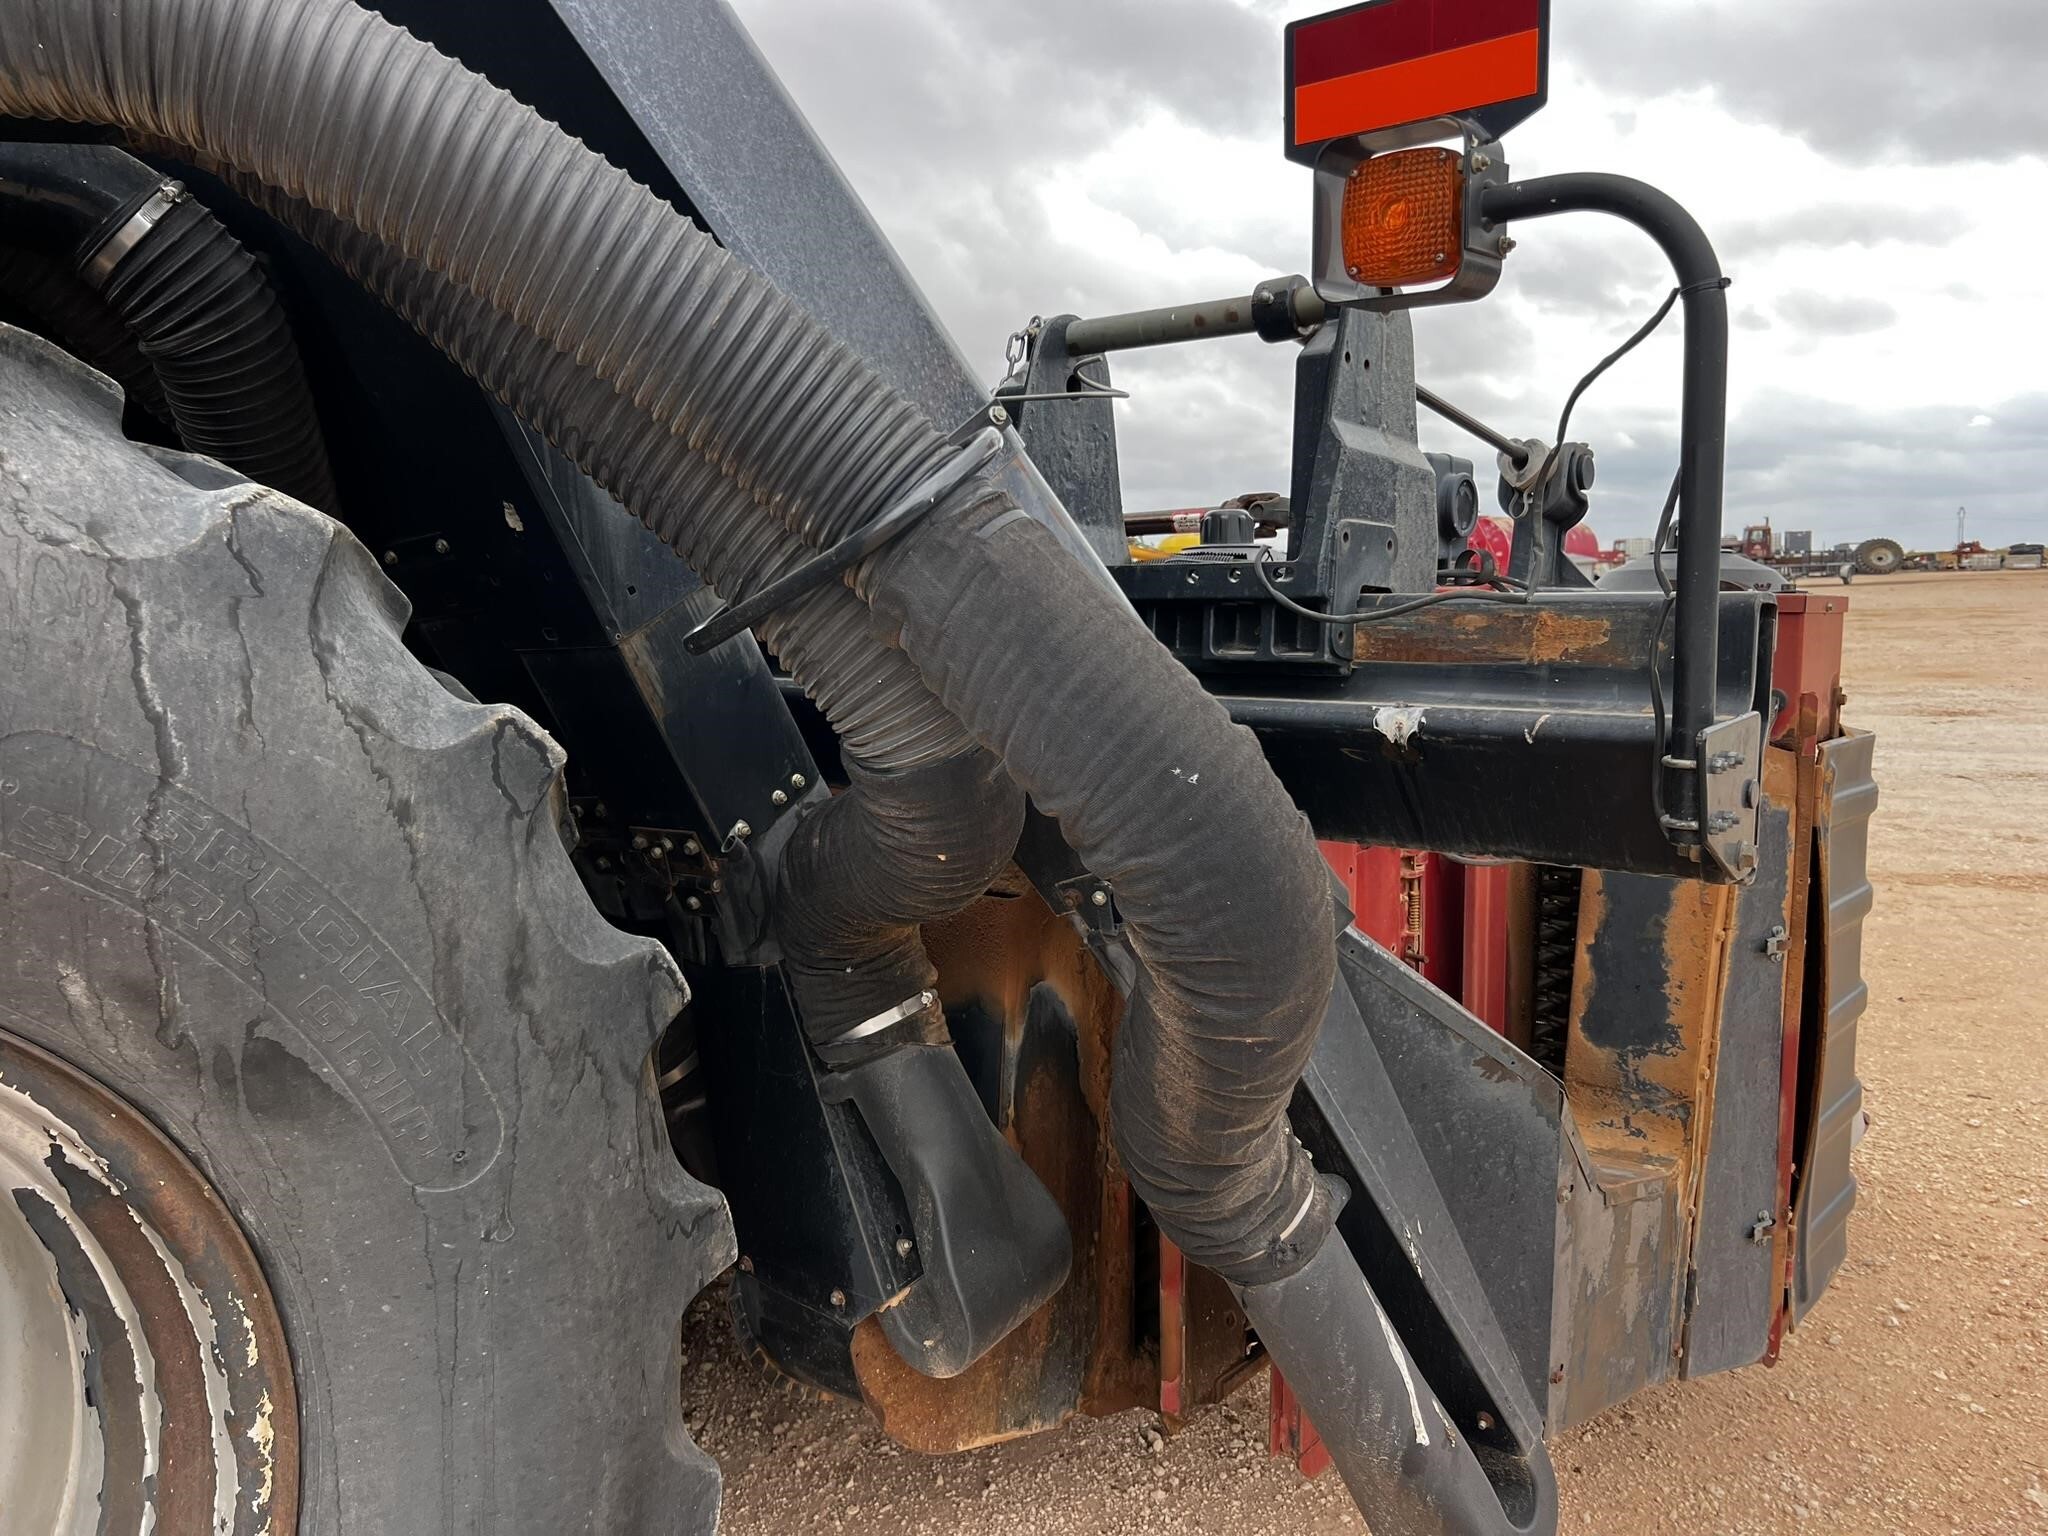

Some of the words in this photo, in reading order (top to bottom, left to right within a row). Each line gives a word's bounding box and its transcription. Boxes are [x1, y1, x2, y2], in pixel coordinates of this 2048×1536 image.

[8, 805, 277, 966] SURE
[296, 985, 442, 1157] GRIP
[133, 799, 441, 1077] SPECIAL
